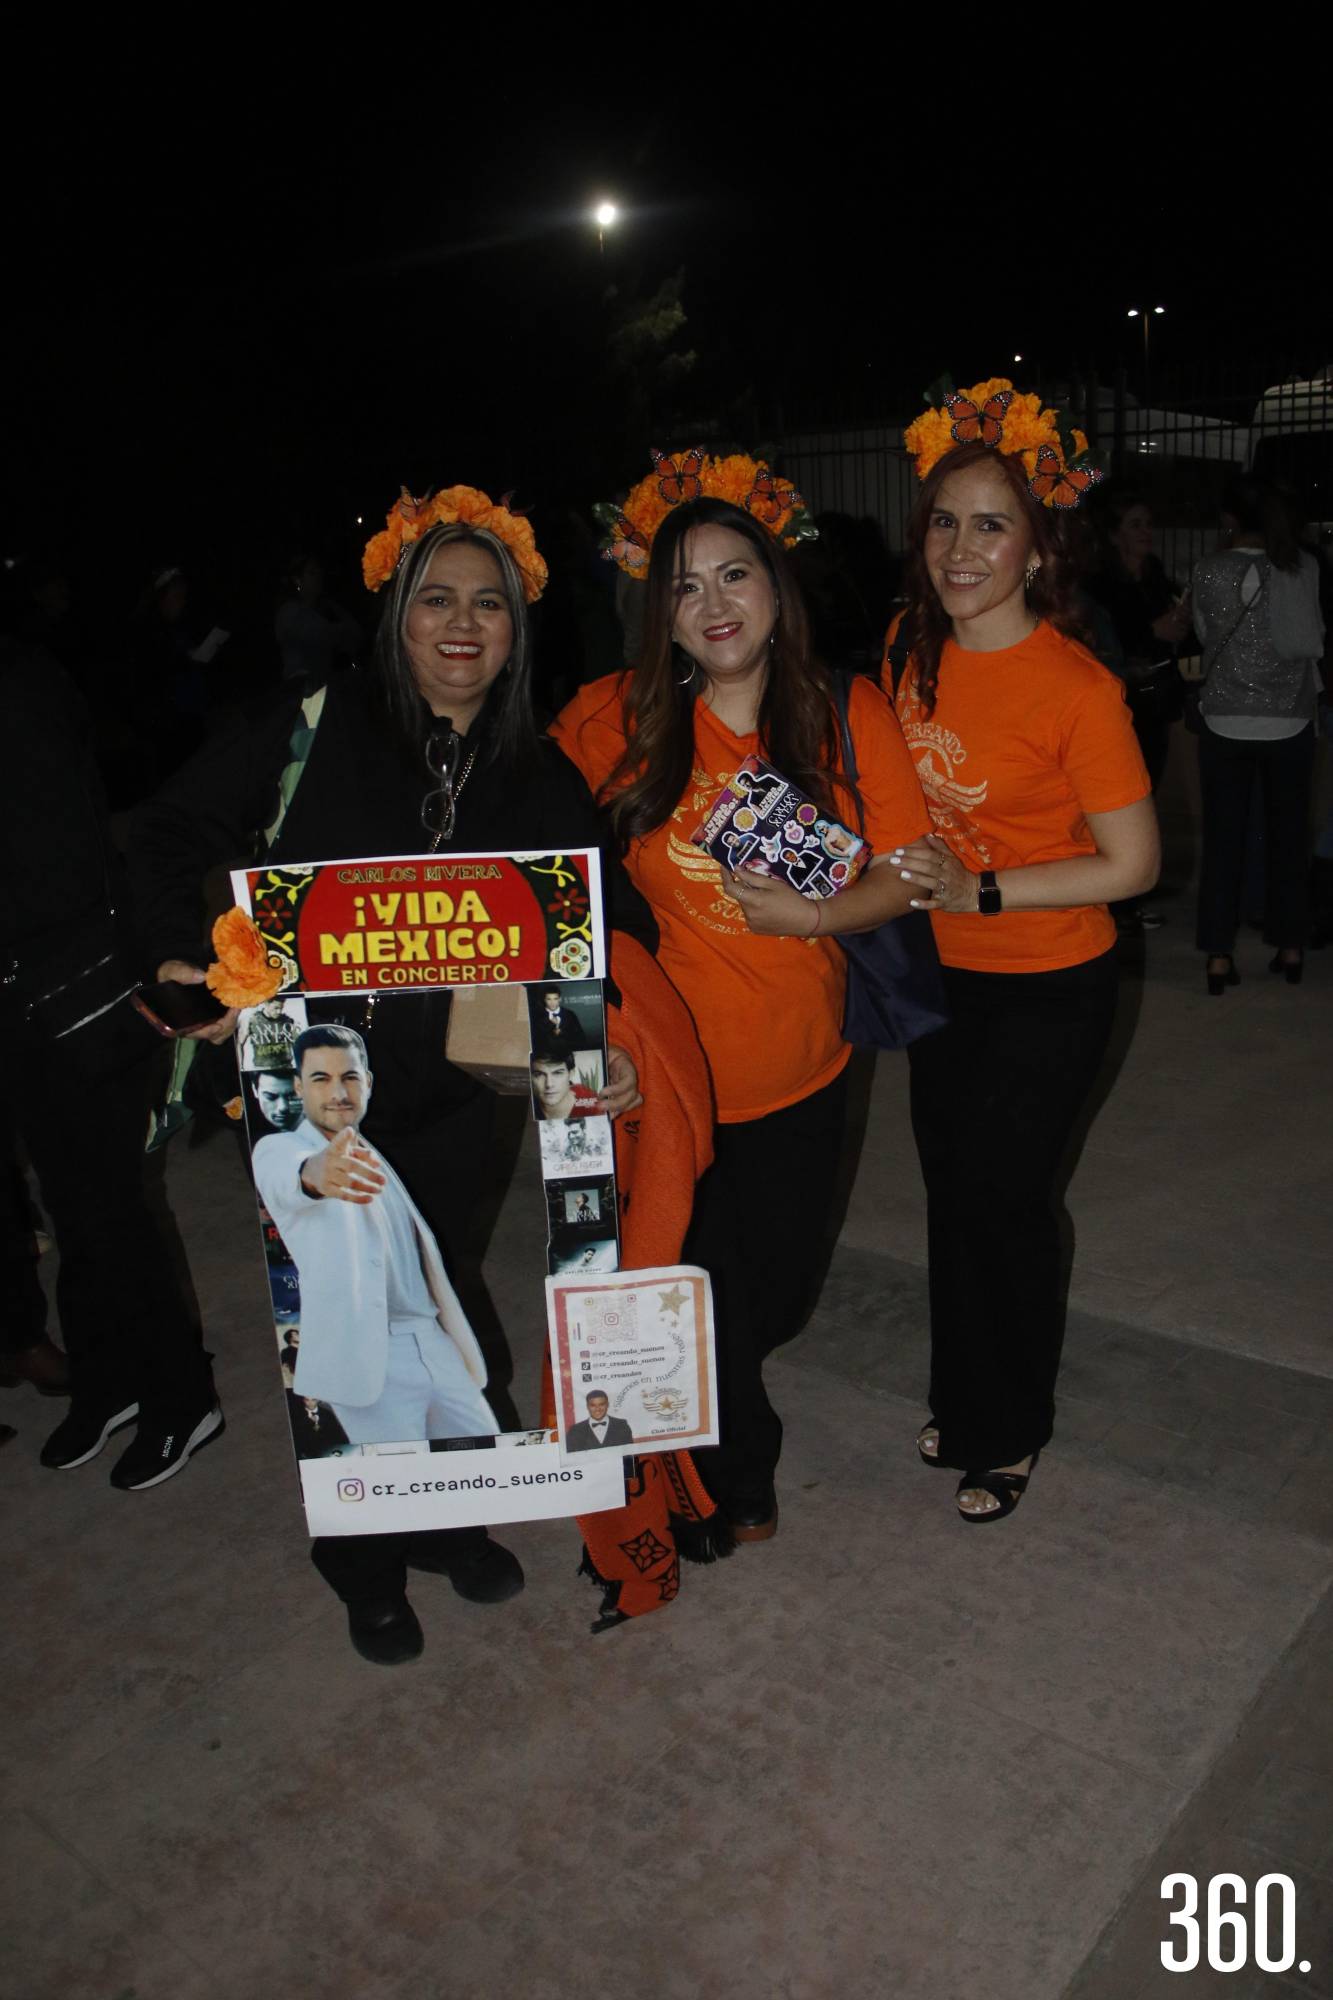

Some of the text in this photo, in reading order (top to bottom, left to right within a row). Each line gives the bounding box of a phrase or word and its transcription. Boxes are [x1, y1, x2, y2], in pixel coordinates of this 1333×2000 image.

[337, 864, 503, 884] CARLOS RIVERA
[353, 889, 491, 927] ¡VIDA
[319, 926, 521, 965] MEXICO!
[340, 963, 509, 985] EN CONCIERTO
[372, 1468, 584, 1496] cr_creando_suenos
